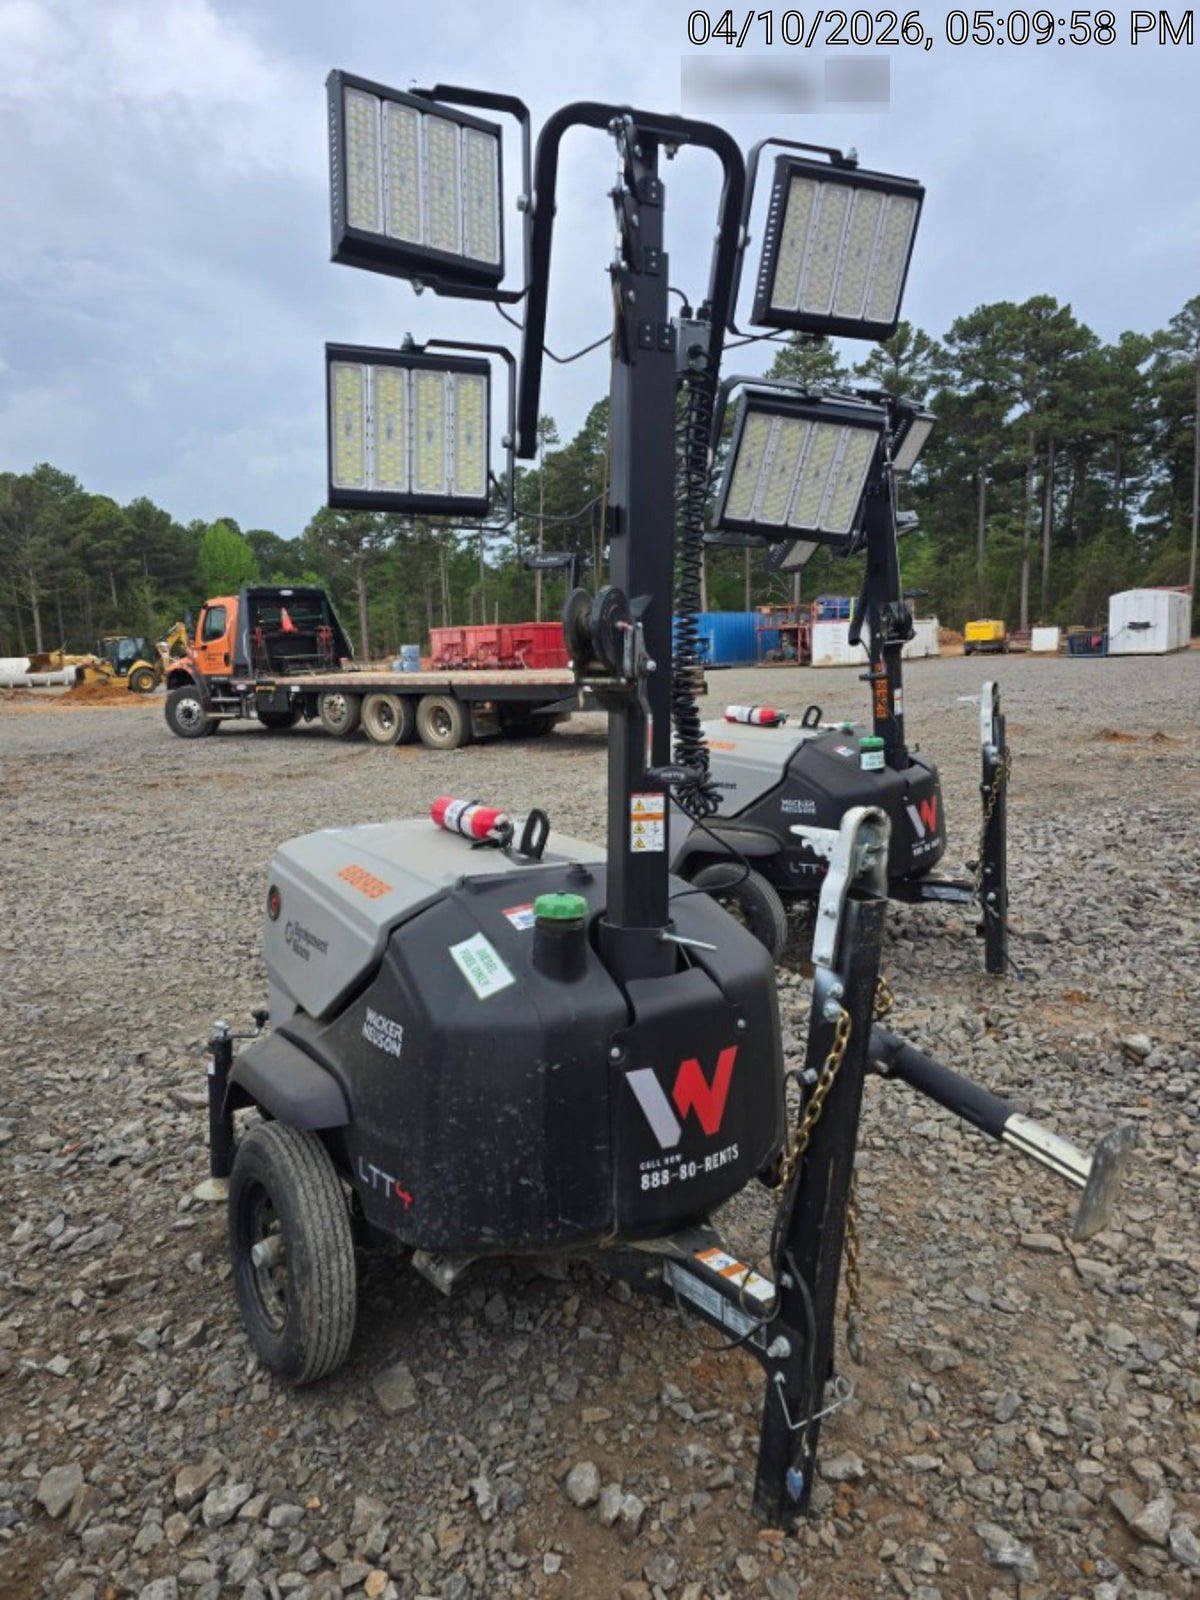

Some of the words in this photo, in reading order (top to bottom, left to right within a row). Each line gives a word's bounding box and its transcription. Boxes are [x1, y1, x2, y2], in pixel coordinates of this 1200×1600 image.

[362, 1021, 402, 1057] NEUSON
[365, 1005, 403, 1042] WACKER
[359, 1156, 413, 1210] LTT4
[640, 1143, 739, 1191] 888-80-RENTS
